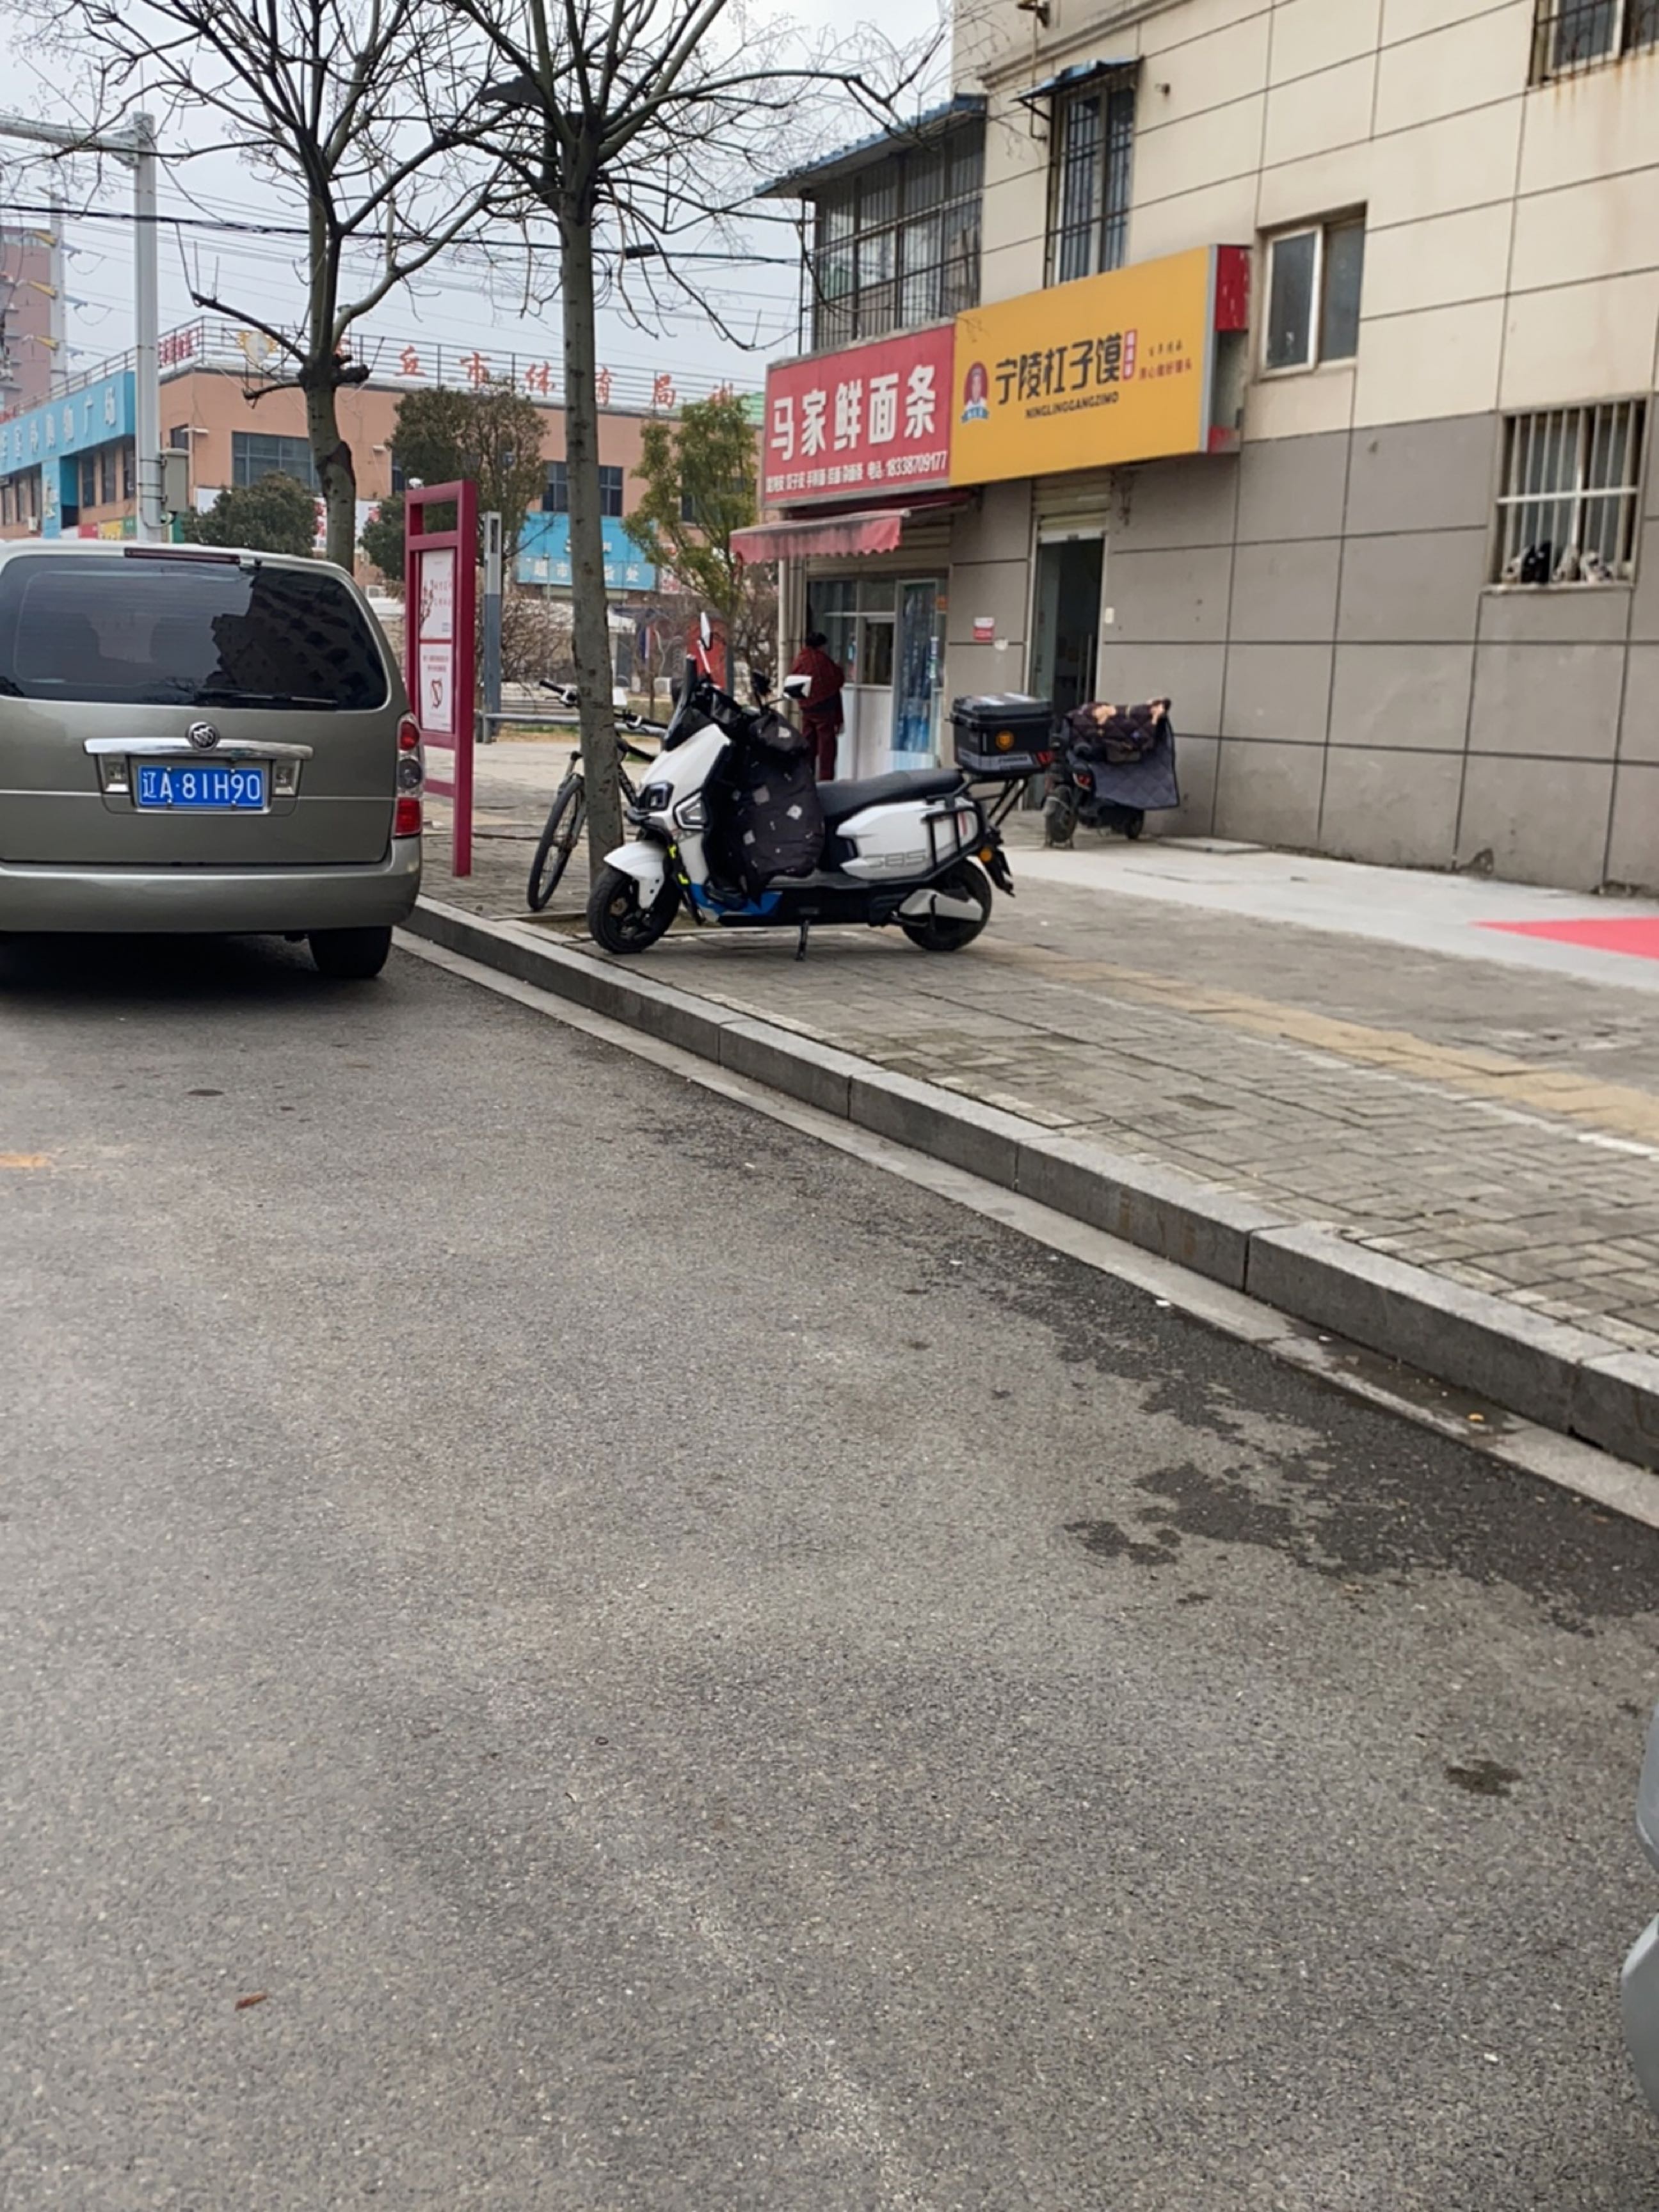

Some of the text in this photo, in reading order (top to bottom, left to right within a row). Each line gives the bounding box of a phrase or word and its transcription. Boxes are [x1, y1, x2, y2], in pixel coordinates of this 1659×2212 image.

[995, 332, 1122, 405] 宁陵杠子馍
[770, 365, 936, 461] 马家鲜面条
